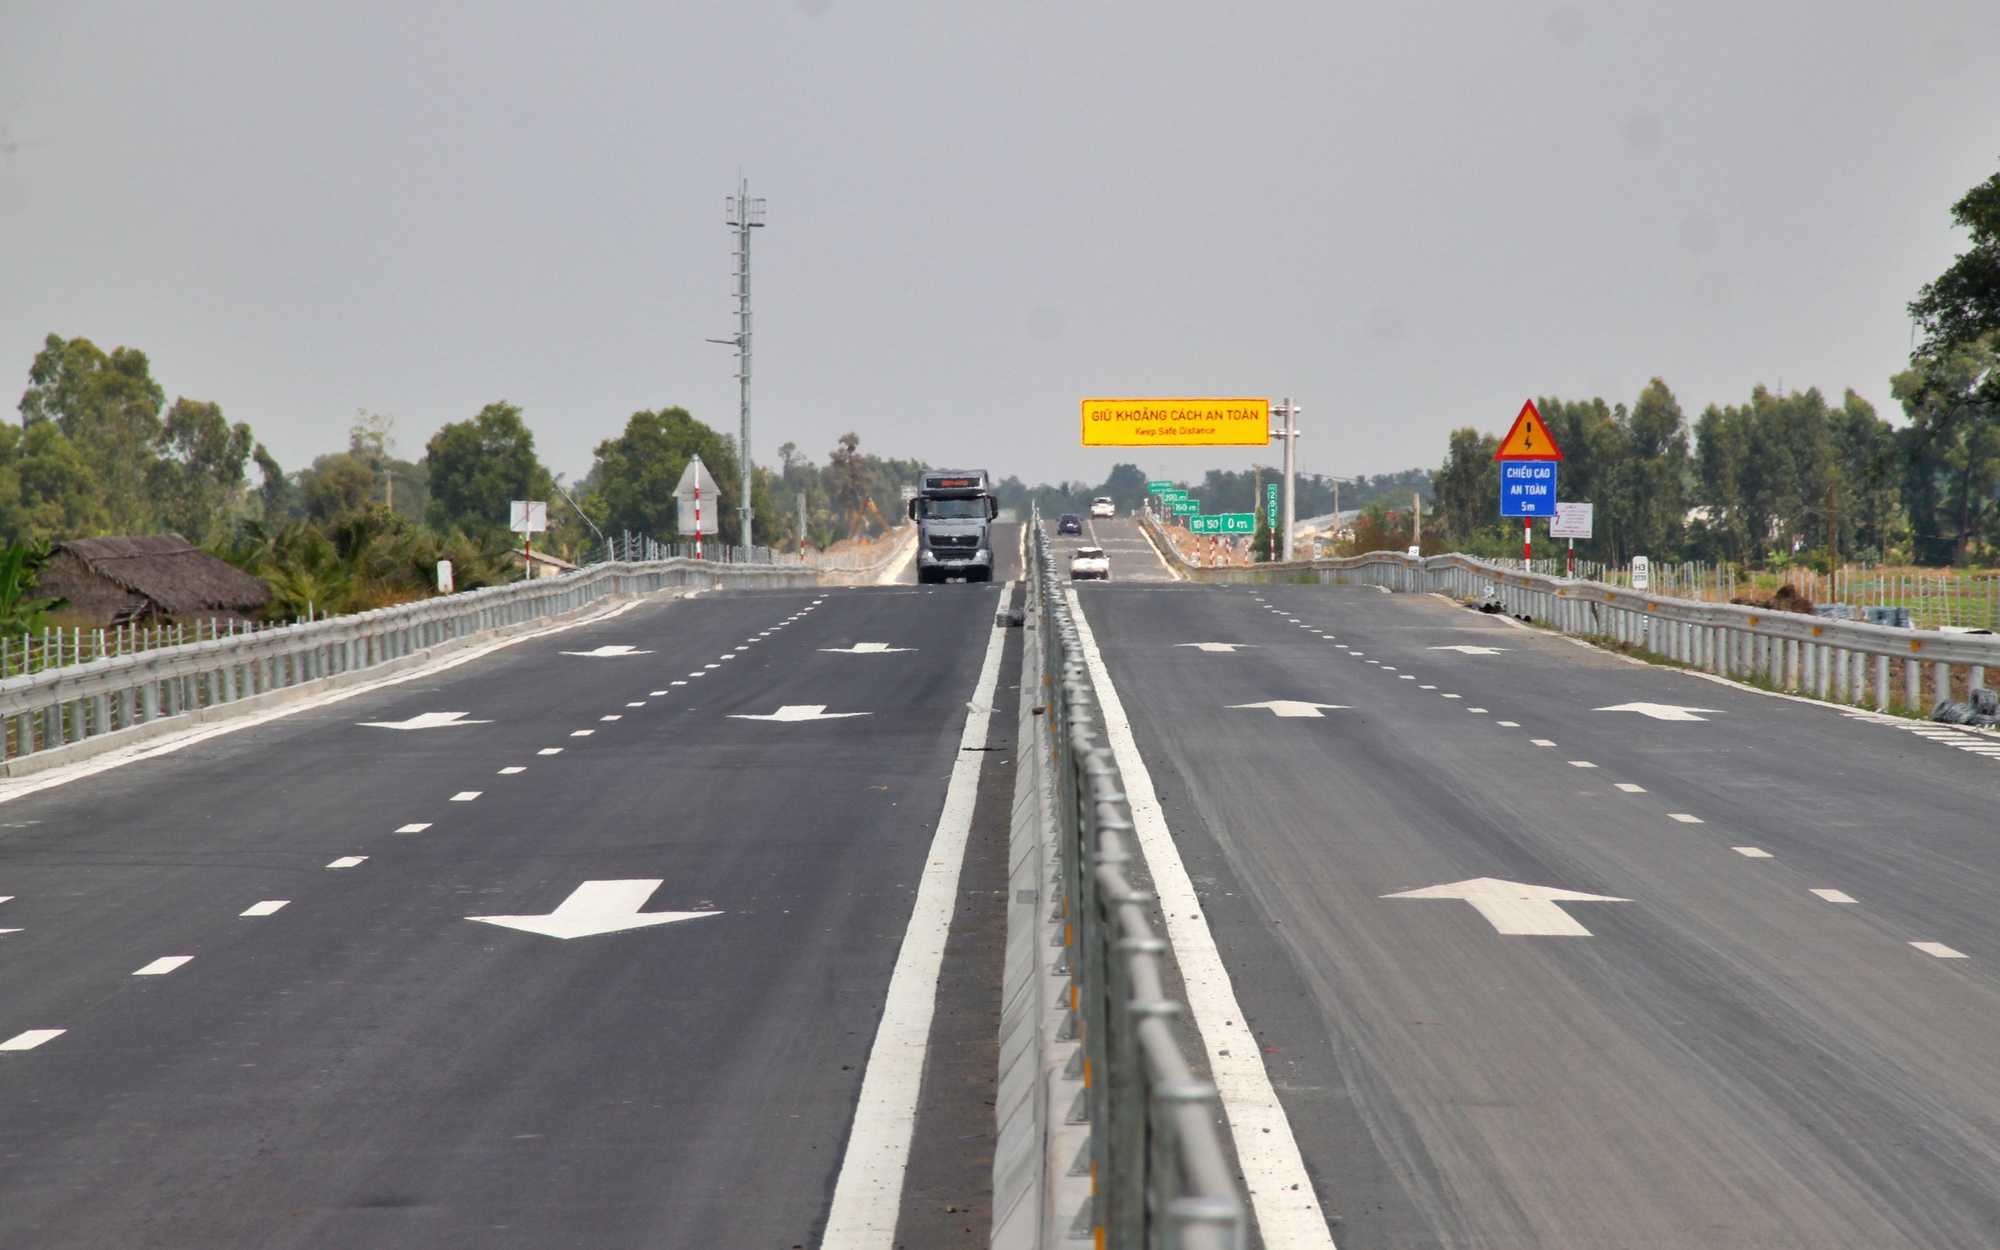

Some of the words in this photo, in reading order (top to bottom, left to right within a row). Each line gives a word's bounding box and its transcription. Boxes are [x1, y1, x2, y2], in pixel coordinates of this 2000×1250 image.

[1091, 408, 1112, 422] GIỮ
[1116, 407, 1167, 421] KHOẢNG
[1170, 408, 1202, 421] CÁCH
[1206, 410, 1223, 421] AN
[1227, 408, 1259, 421] TOÀN
[1135, 427, 1156, 437] Keep
[1158, 427, 1177, 436] Safe
[1179, 427, 1216, 436] Distance
[1534, 468, 1551, 479] CAO
[1510, 484, 1522, 495] AN
[1524, 483, 1547, 495] TOÀN
[1521, 501, 1535, 512] 5m
[1207, 519, 1219, 529] 50
[1236, 520, 1248, 529] m
[1634, 563, 1646, 571] H3
